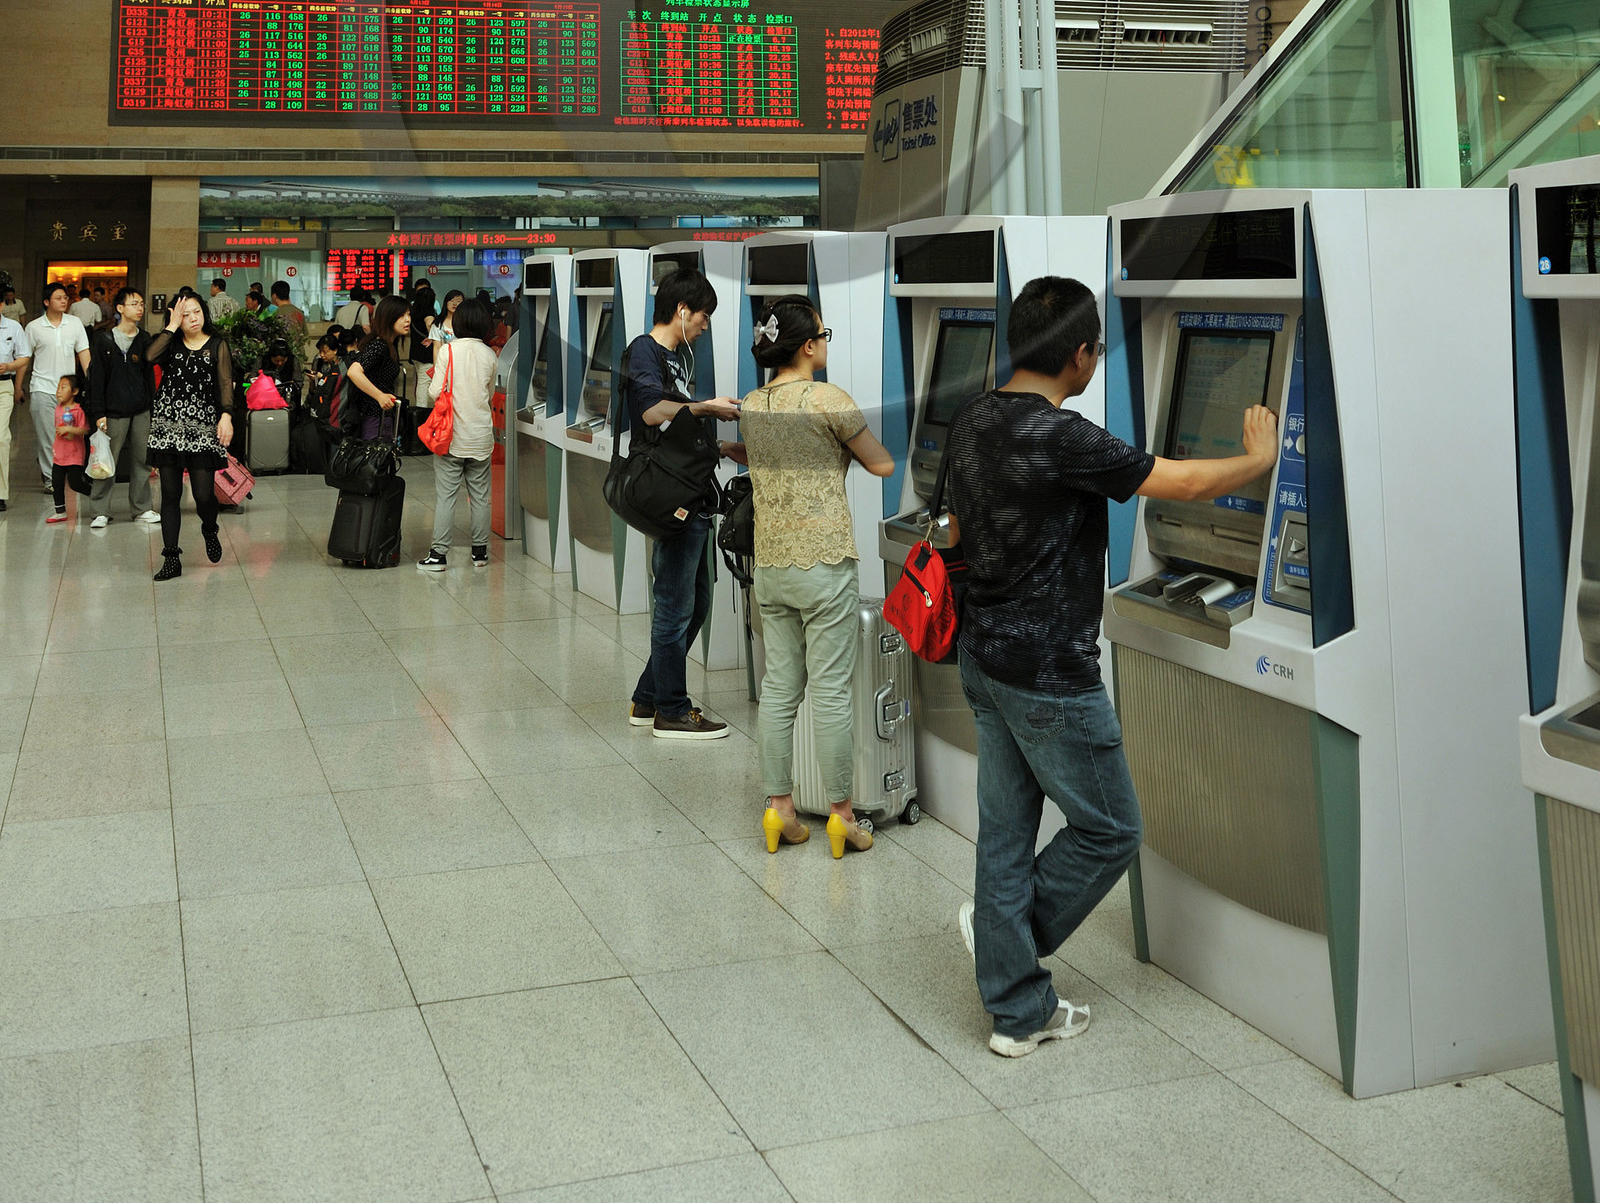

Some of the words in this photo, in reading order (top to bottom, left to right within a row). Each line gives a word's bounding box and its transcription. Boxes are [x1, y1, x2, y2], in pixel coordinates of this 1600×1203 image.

[126, 8, 148, 16] D335
[202, 10, 226, 18] 10:21
[288, 13, 304, 21] 458
[364, 15, 379, 23] 575
[660, 11, 689, 21] 终到站
[765, 14, 793, 24] 检票口
[126, 18, 147, 26] G121
[201, 20, 227, 28] 10:36
[126, 28, 147, 36] G123
[201, 30, 227, 38] 10:53
[1255, 6, 1273, 61] Offic
[128, 38, 145, 46] G15
[201, 39, 227, 47] 11:00
[267, 41, 276, 49] 91
[417, 45, 431, 53] 106
[825, 40, 881, 50] 客列车均预留
[128, 48, 145, 56] G35
[201, 59, 226, 67] 11:15
[200, 69, 226, 77] 11:20
[200, 79, 225, 87] 11:25
[200, 89, 225, 97] 11:45
[200, 100, 225, 108] 11:53
[826, 111, 870, 121] 3、普通旅
[902, 95, 938, 133] 售票处
[901, 136, 918, 151] Ticket
[918, 133, 936, 148] Office
[49, 220, 128, 242] 贵宾室
[386, 233, 478, 246] 本售票厅售票时间
[1540, 260, 1549, 271] 28
[1273, 663, 1294, 681] CRH
